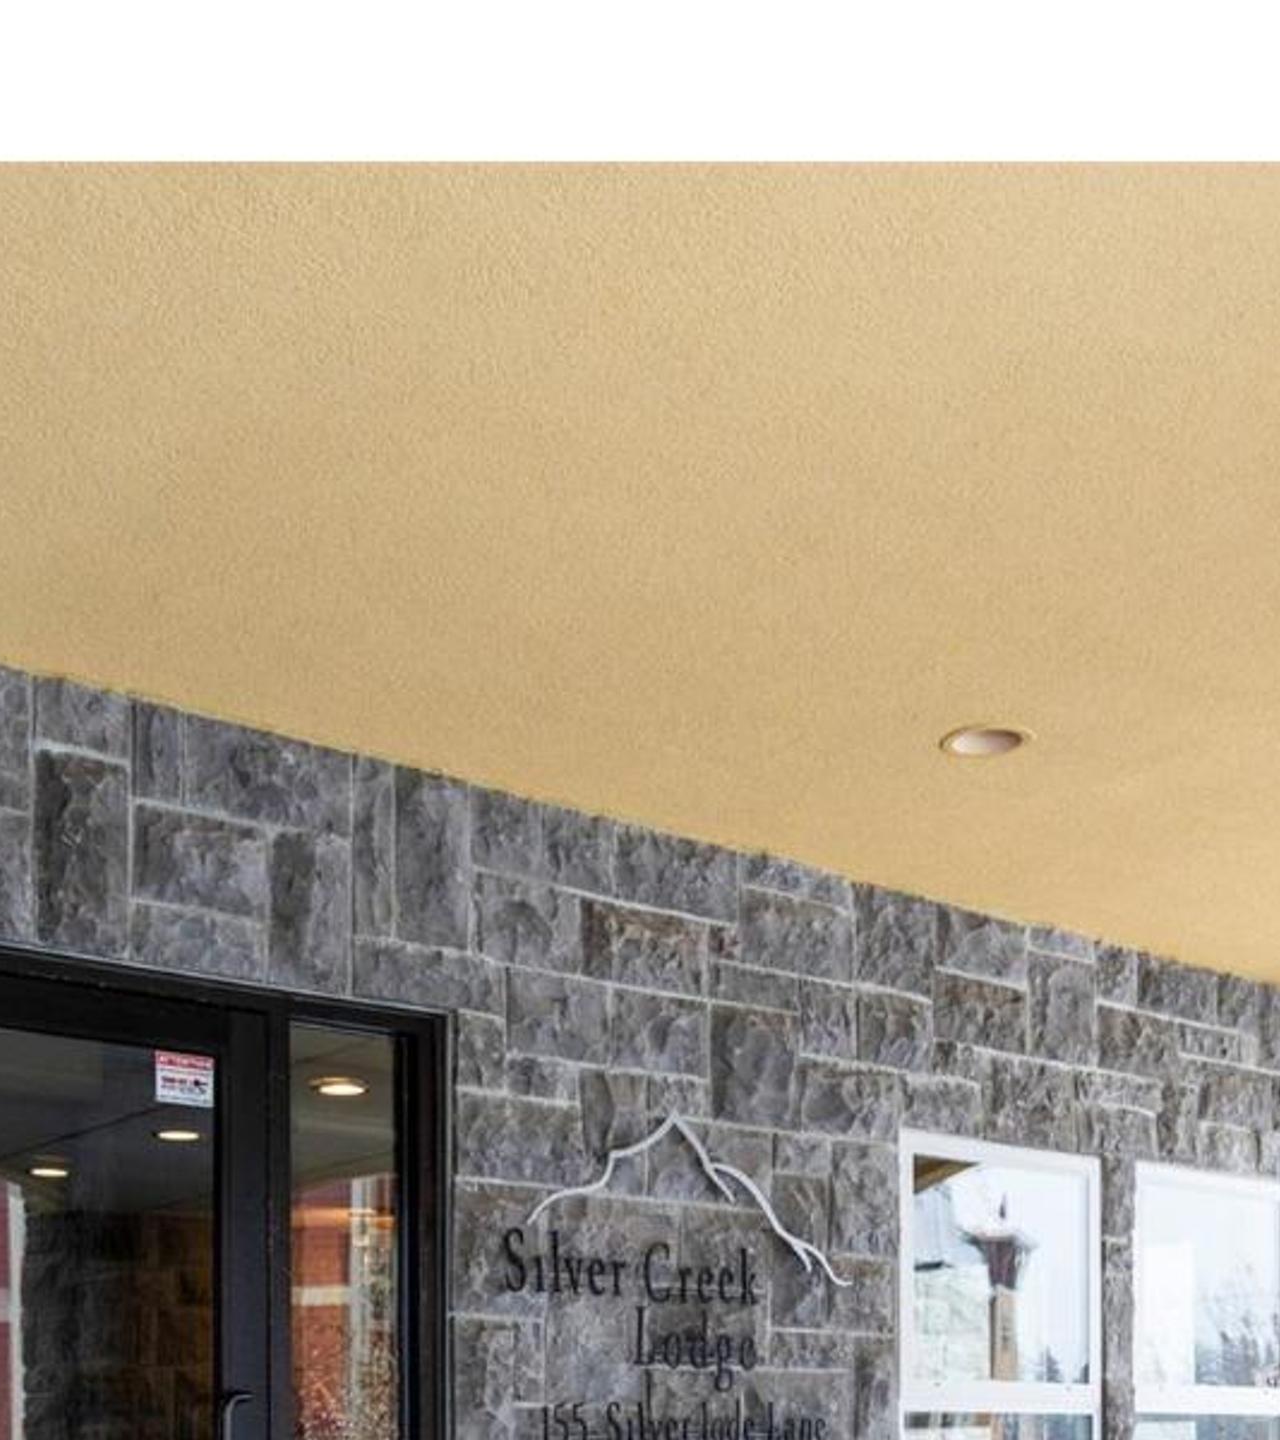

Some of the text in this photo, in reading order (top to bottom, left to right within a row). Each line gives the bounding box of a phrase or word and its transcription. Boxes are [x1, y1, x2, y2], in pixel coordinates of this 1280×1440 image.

[502, 1227, 759, 1305] Silver Creek
[634, 1305, 757, 1392] Lodge
